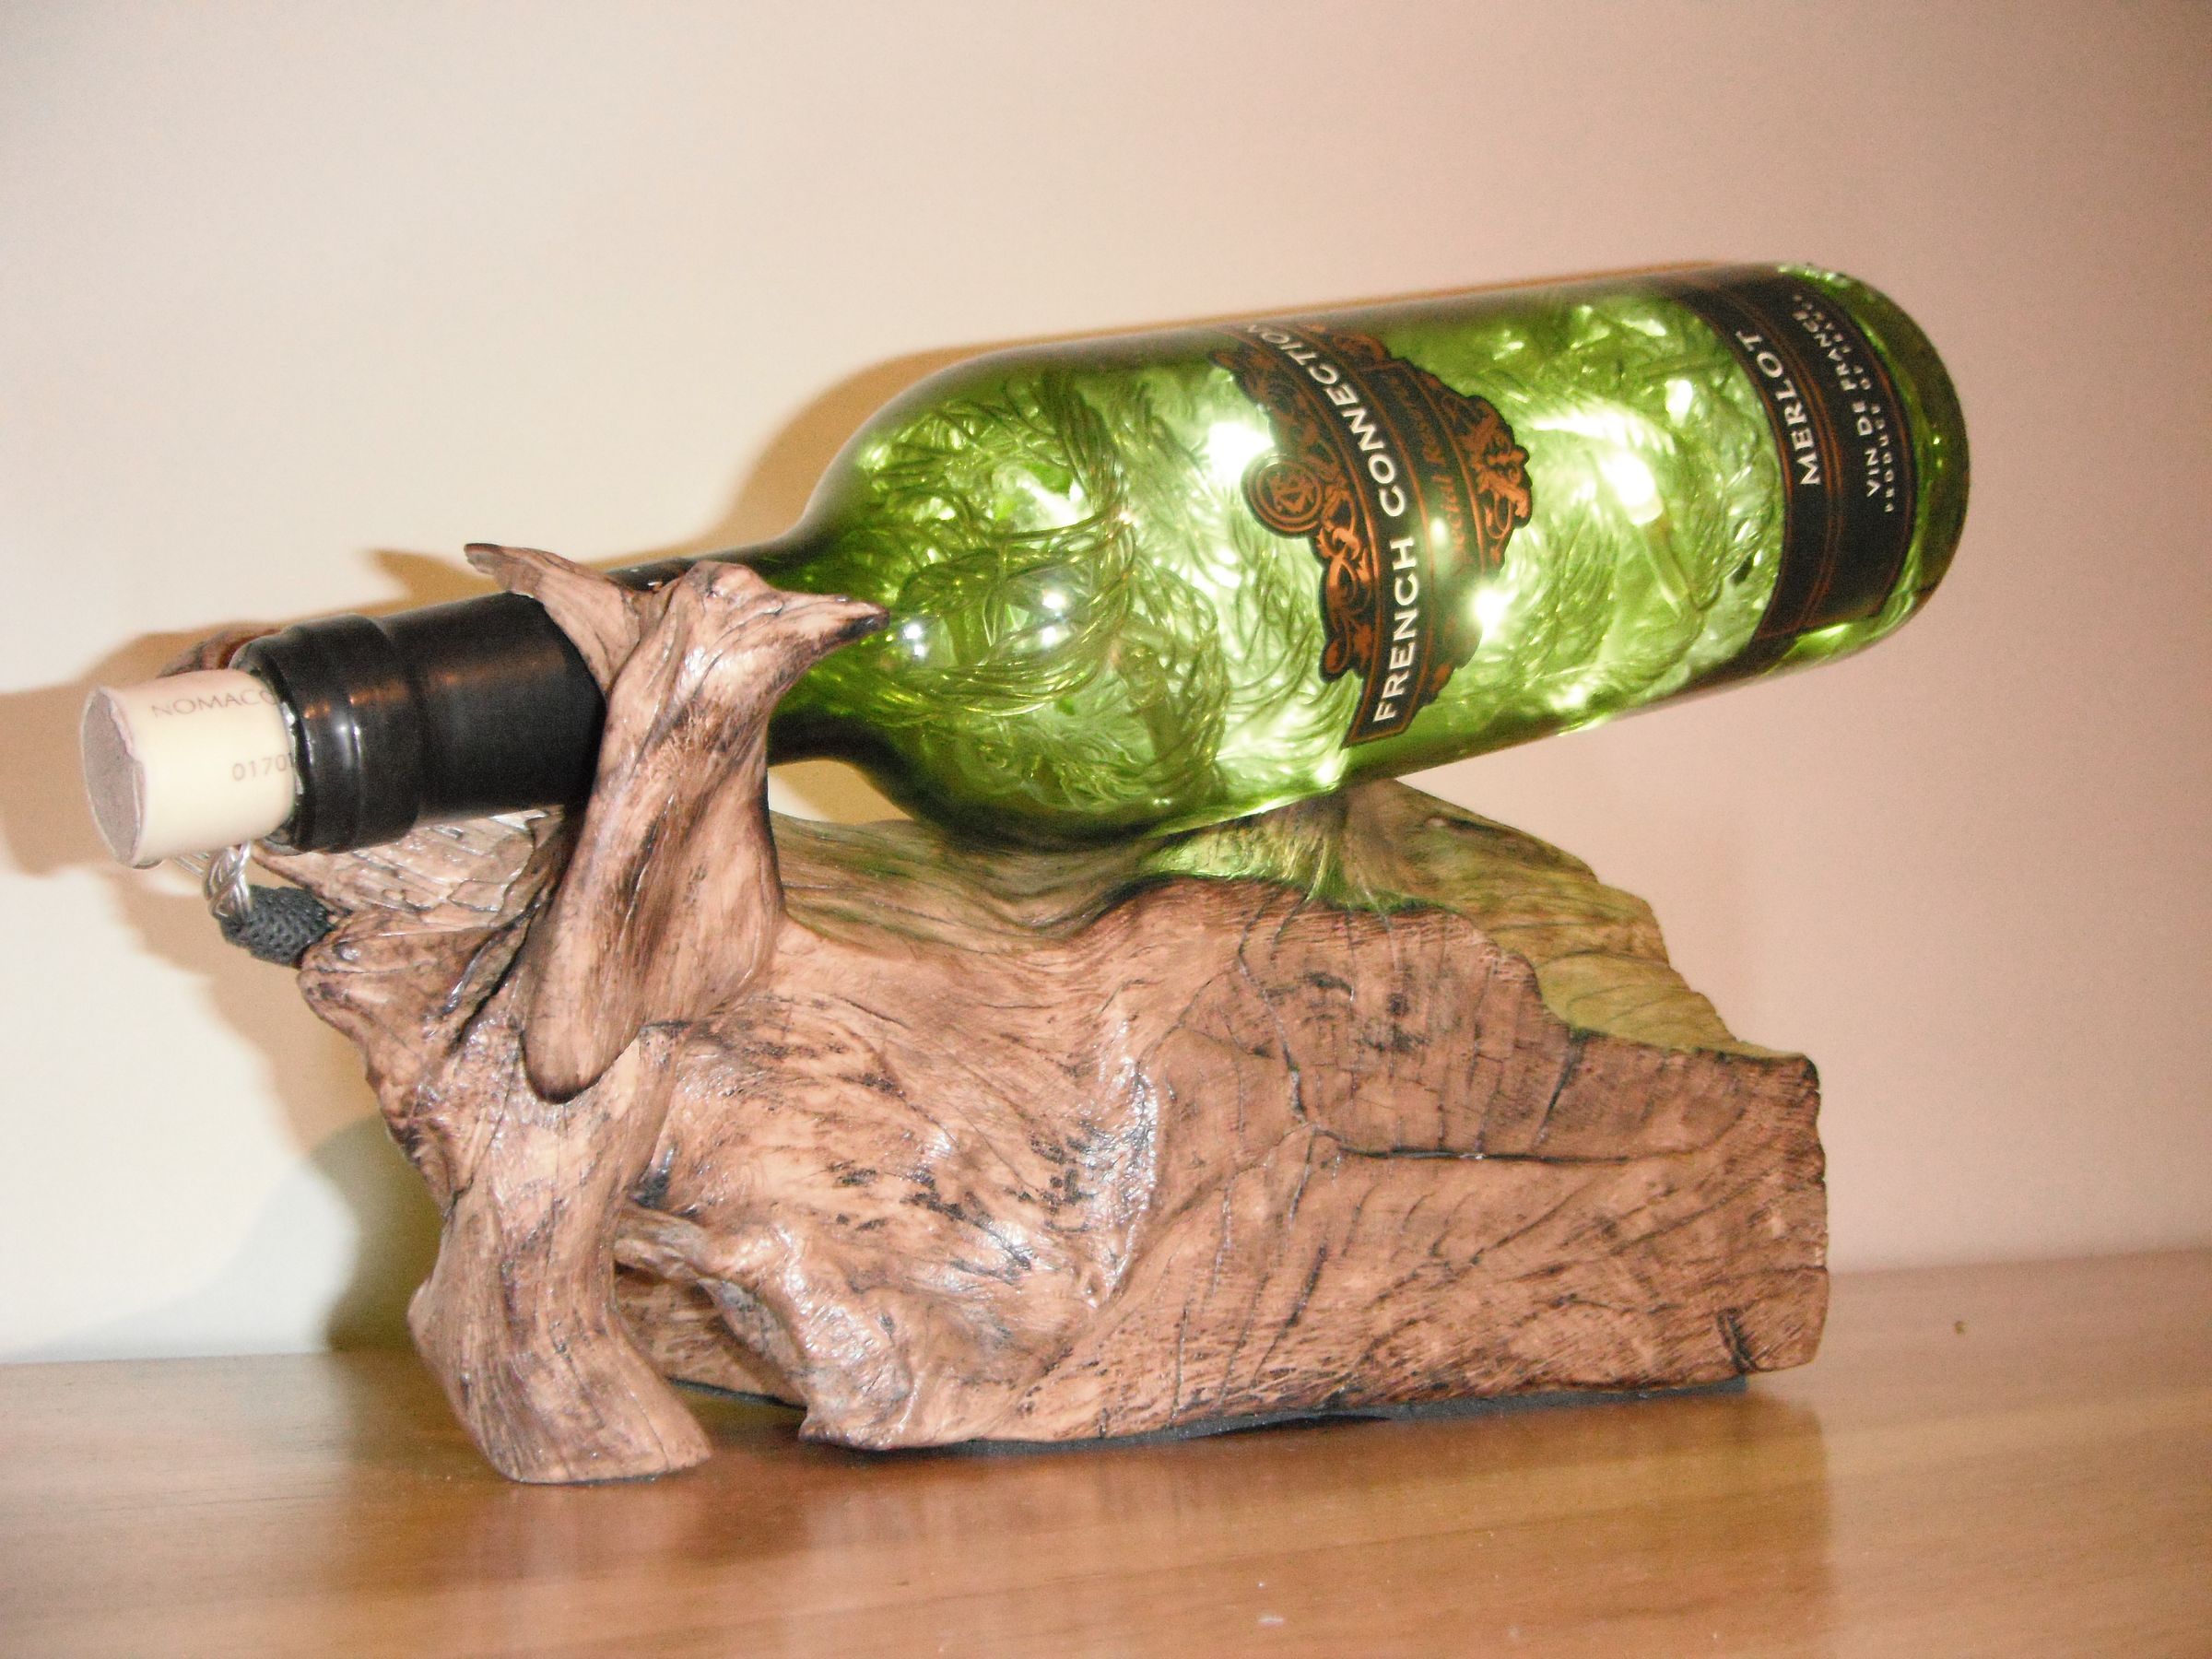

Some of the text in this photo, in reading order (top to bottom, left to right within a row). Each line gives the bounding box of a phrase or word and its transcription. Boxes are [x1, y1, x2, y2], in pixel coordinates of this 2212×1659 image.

[1735, 330, 1822, 485] MERLOT
[1794, 310, 1881, 498] VIN DE FRANCE
[1372, 536, 1418, 723] FRENCH
